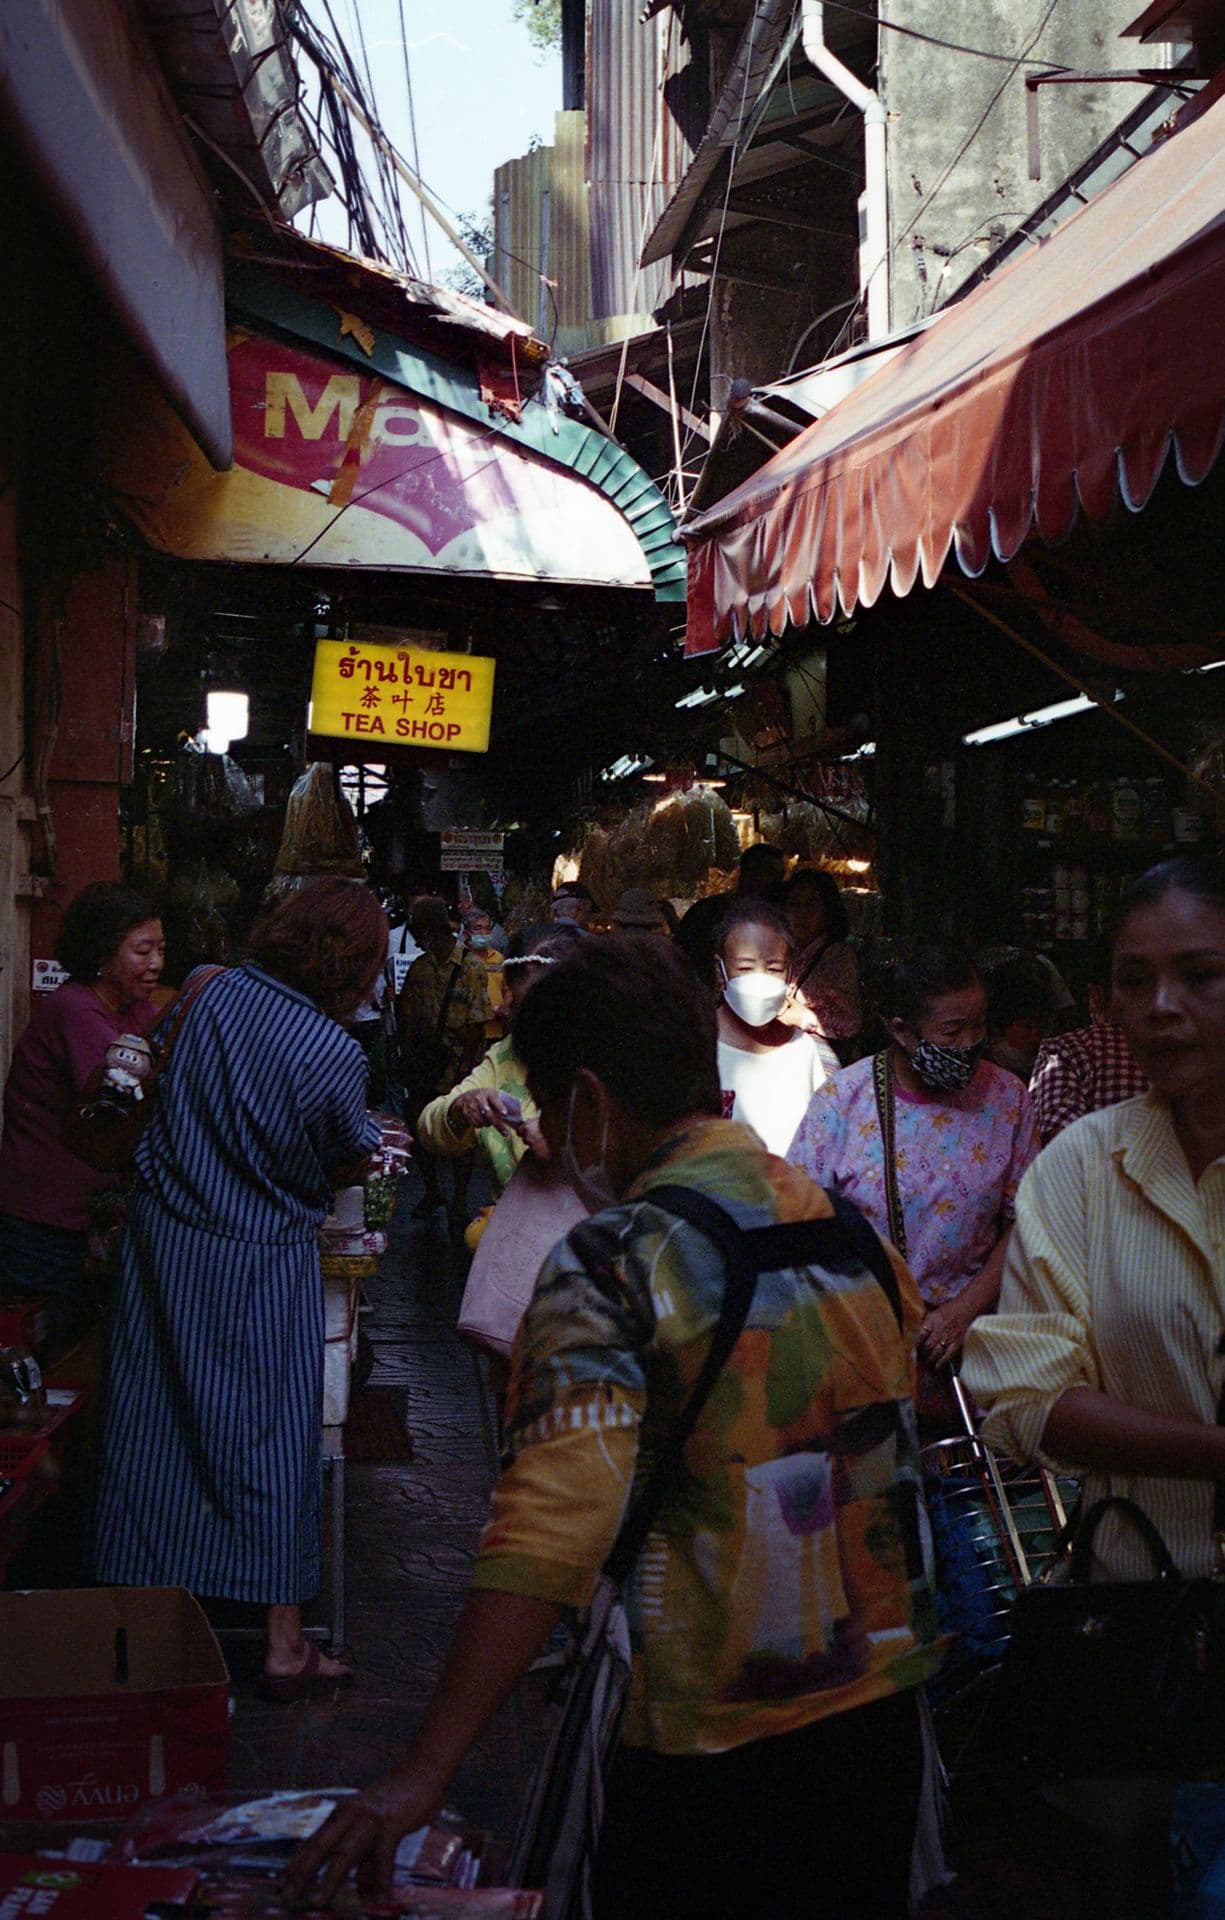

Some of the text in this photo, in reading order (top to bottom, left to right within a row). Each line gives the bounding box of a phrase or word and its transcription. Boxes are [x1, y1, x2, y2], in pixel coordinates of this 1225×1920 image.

[338, 646, 472, 692] ร้านใบชา
[359, 685, 446, 716] 茶叶店
[341, 712, 462, 741] TEA SHOP
[68, 1772, 139, 1806] envy
